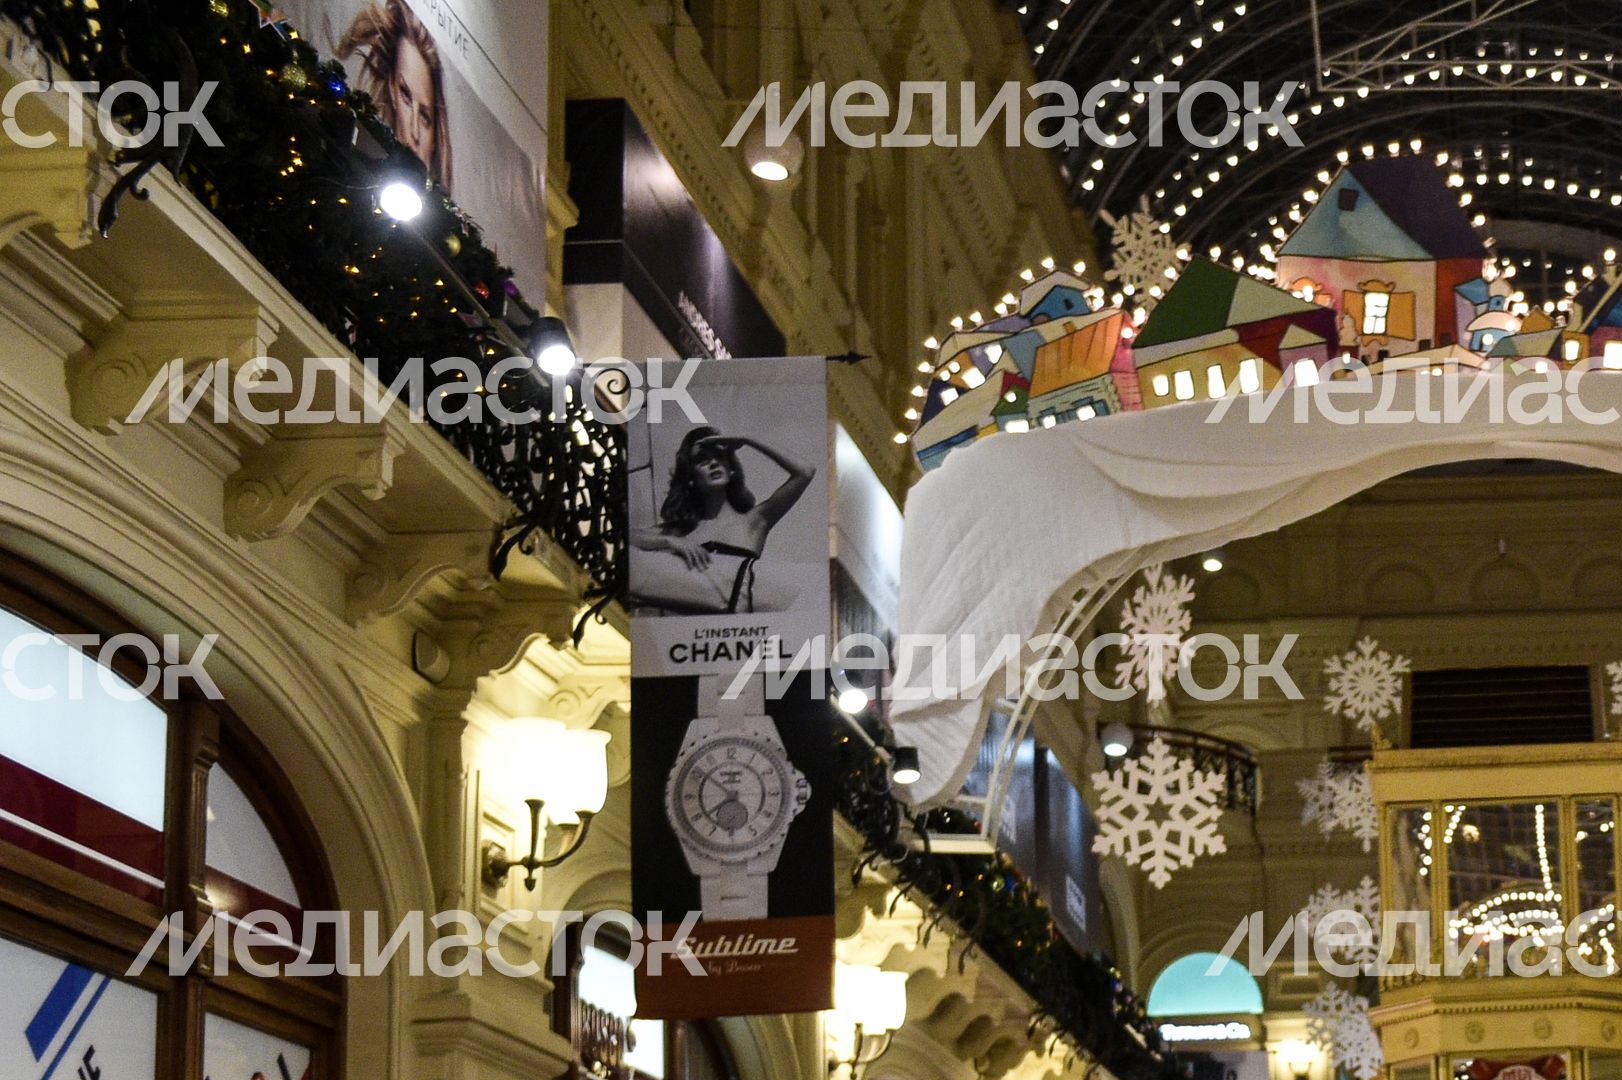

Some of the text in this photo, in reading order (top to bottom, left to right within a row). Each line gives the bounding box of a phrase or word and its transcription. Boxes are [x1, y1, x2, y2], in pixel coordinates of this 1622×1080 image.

[695, 626, 769, 640] L'INSTANT
[669, 639, 793, 664] CHANEL
[670, 933, 800, 960] Sublime
